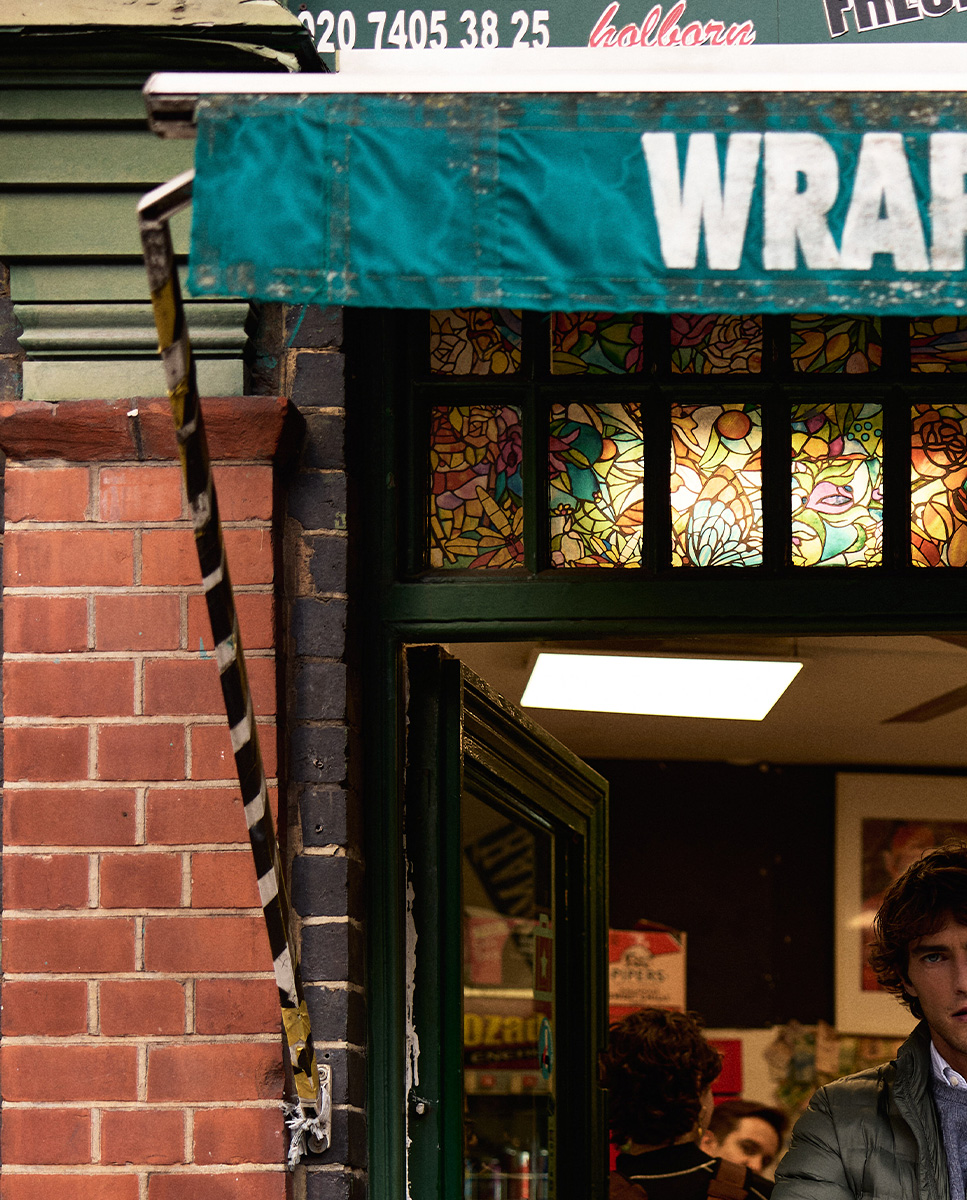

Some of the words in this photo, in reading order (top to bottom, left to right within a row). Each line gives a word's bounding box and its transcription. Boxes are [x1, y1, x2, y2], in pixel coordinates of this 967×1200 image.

[367, 10, 447, 50] 7405
[460, 10, 499, 49] 38
[510, 10, 550, 49] 25
[588, 0, 756, 47] holborn
